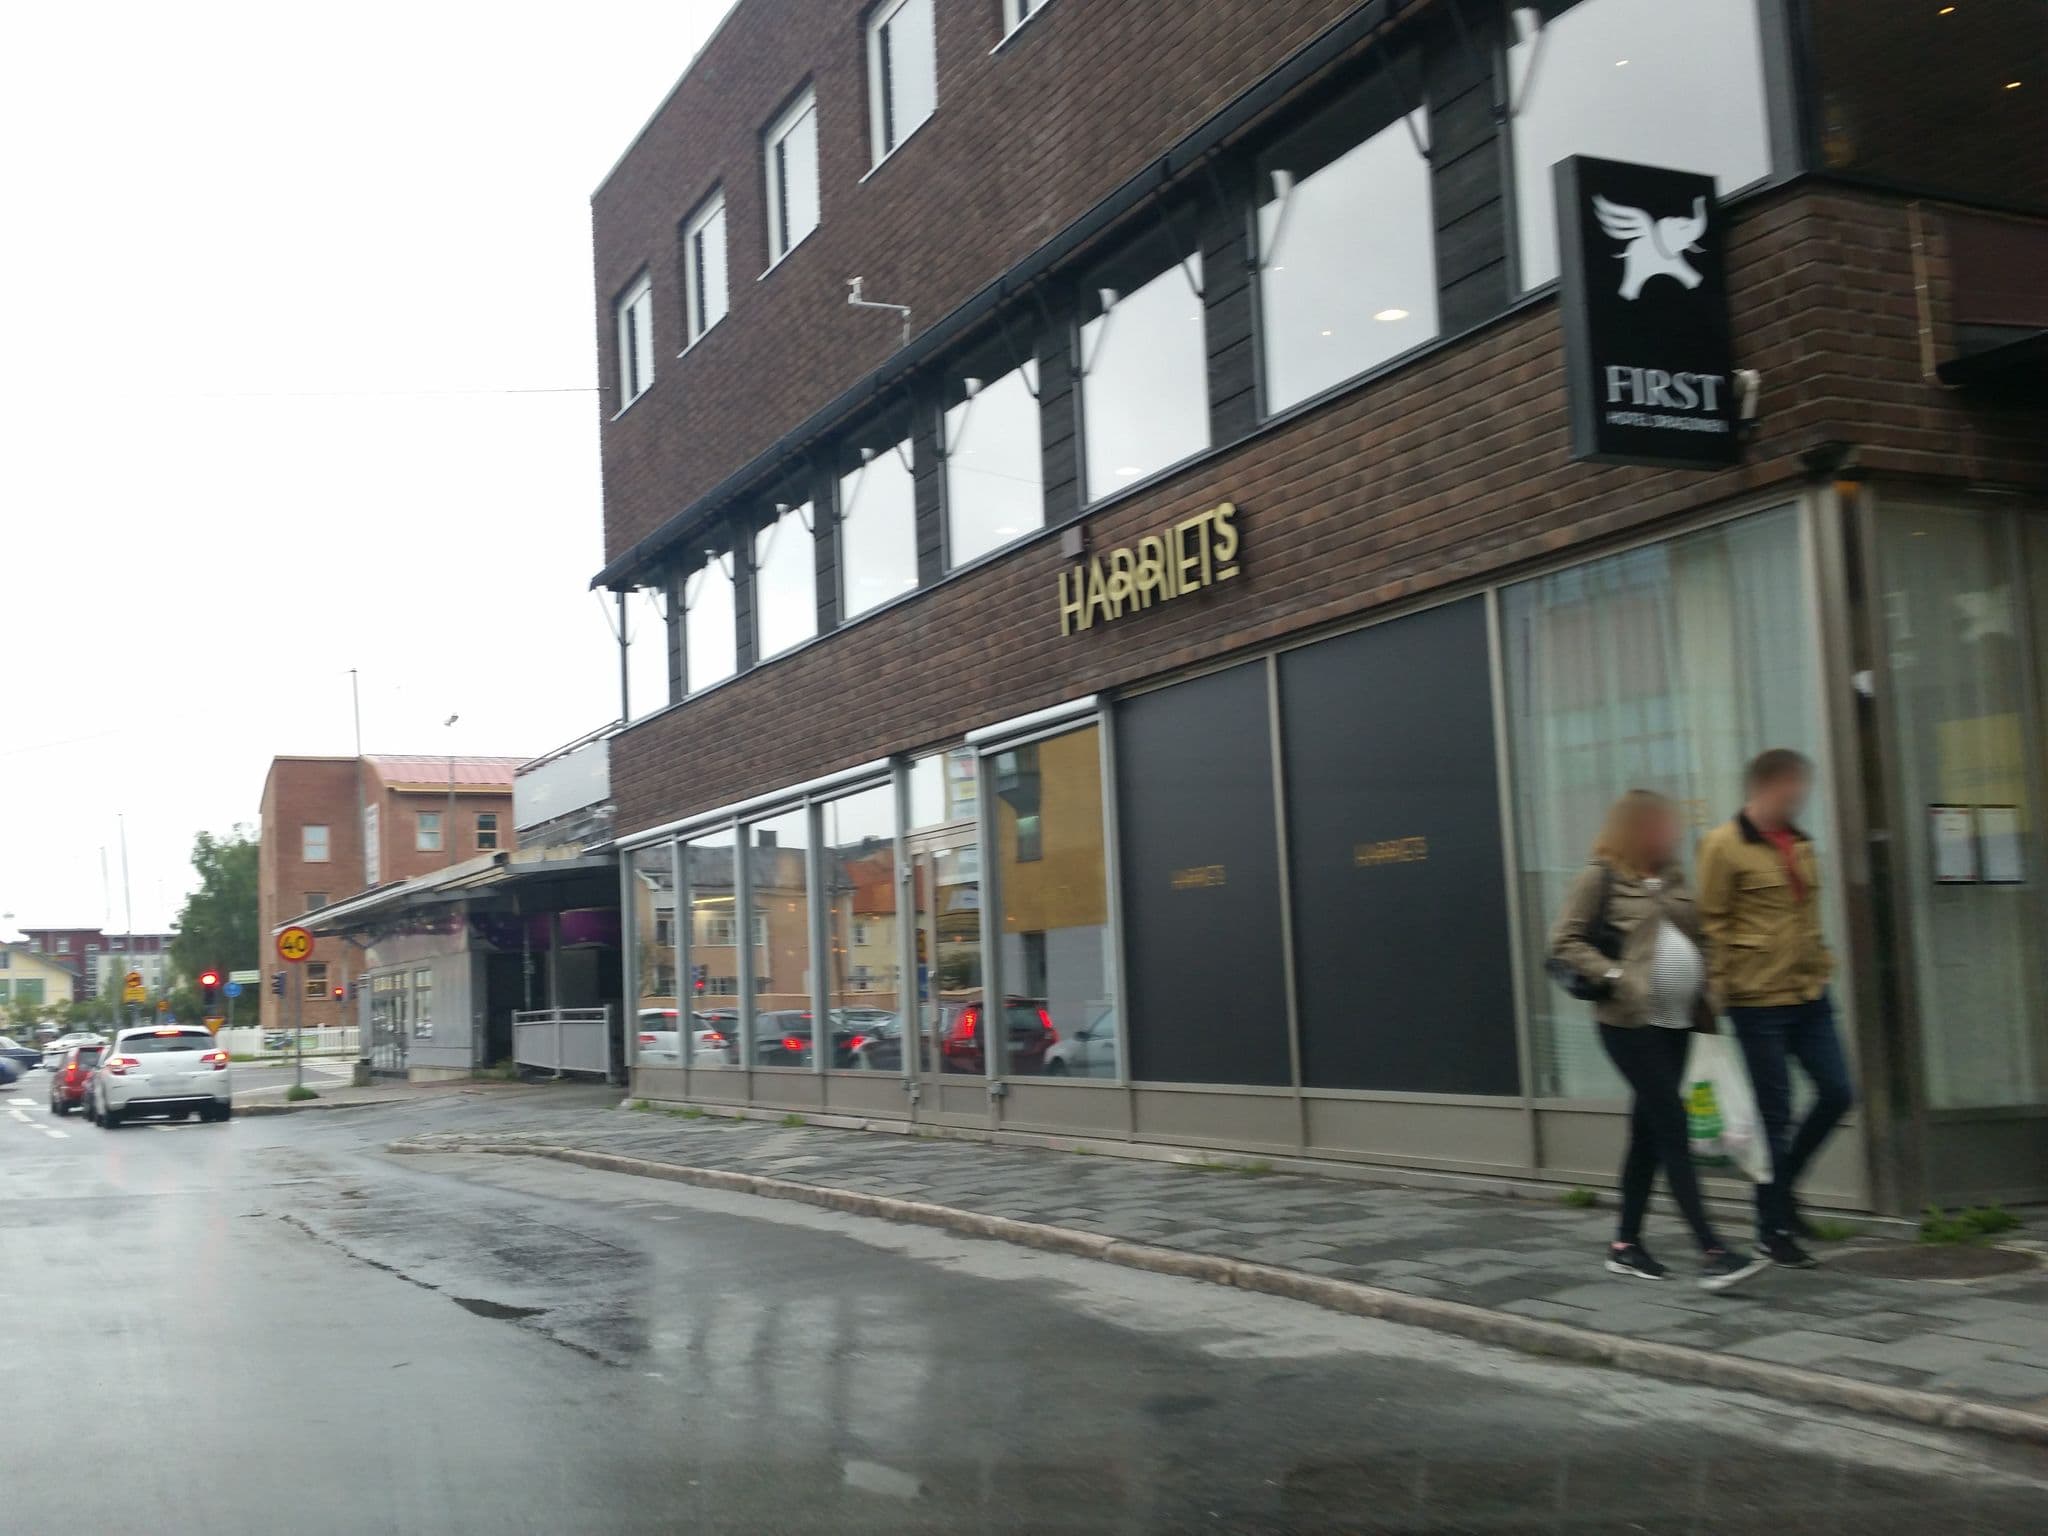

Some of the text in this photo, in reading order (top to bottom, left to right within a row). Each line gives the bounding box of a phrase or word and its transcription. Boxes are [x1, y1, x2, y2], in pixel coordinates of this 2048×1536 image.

[1605, 365, 1725, 411] FIRST
[1058, 502, 1240, 637] HARRIETS
[282, 935, 307, 953] 40
